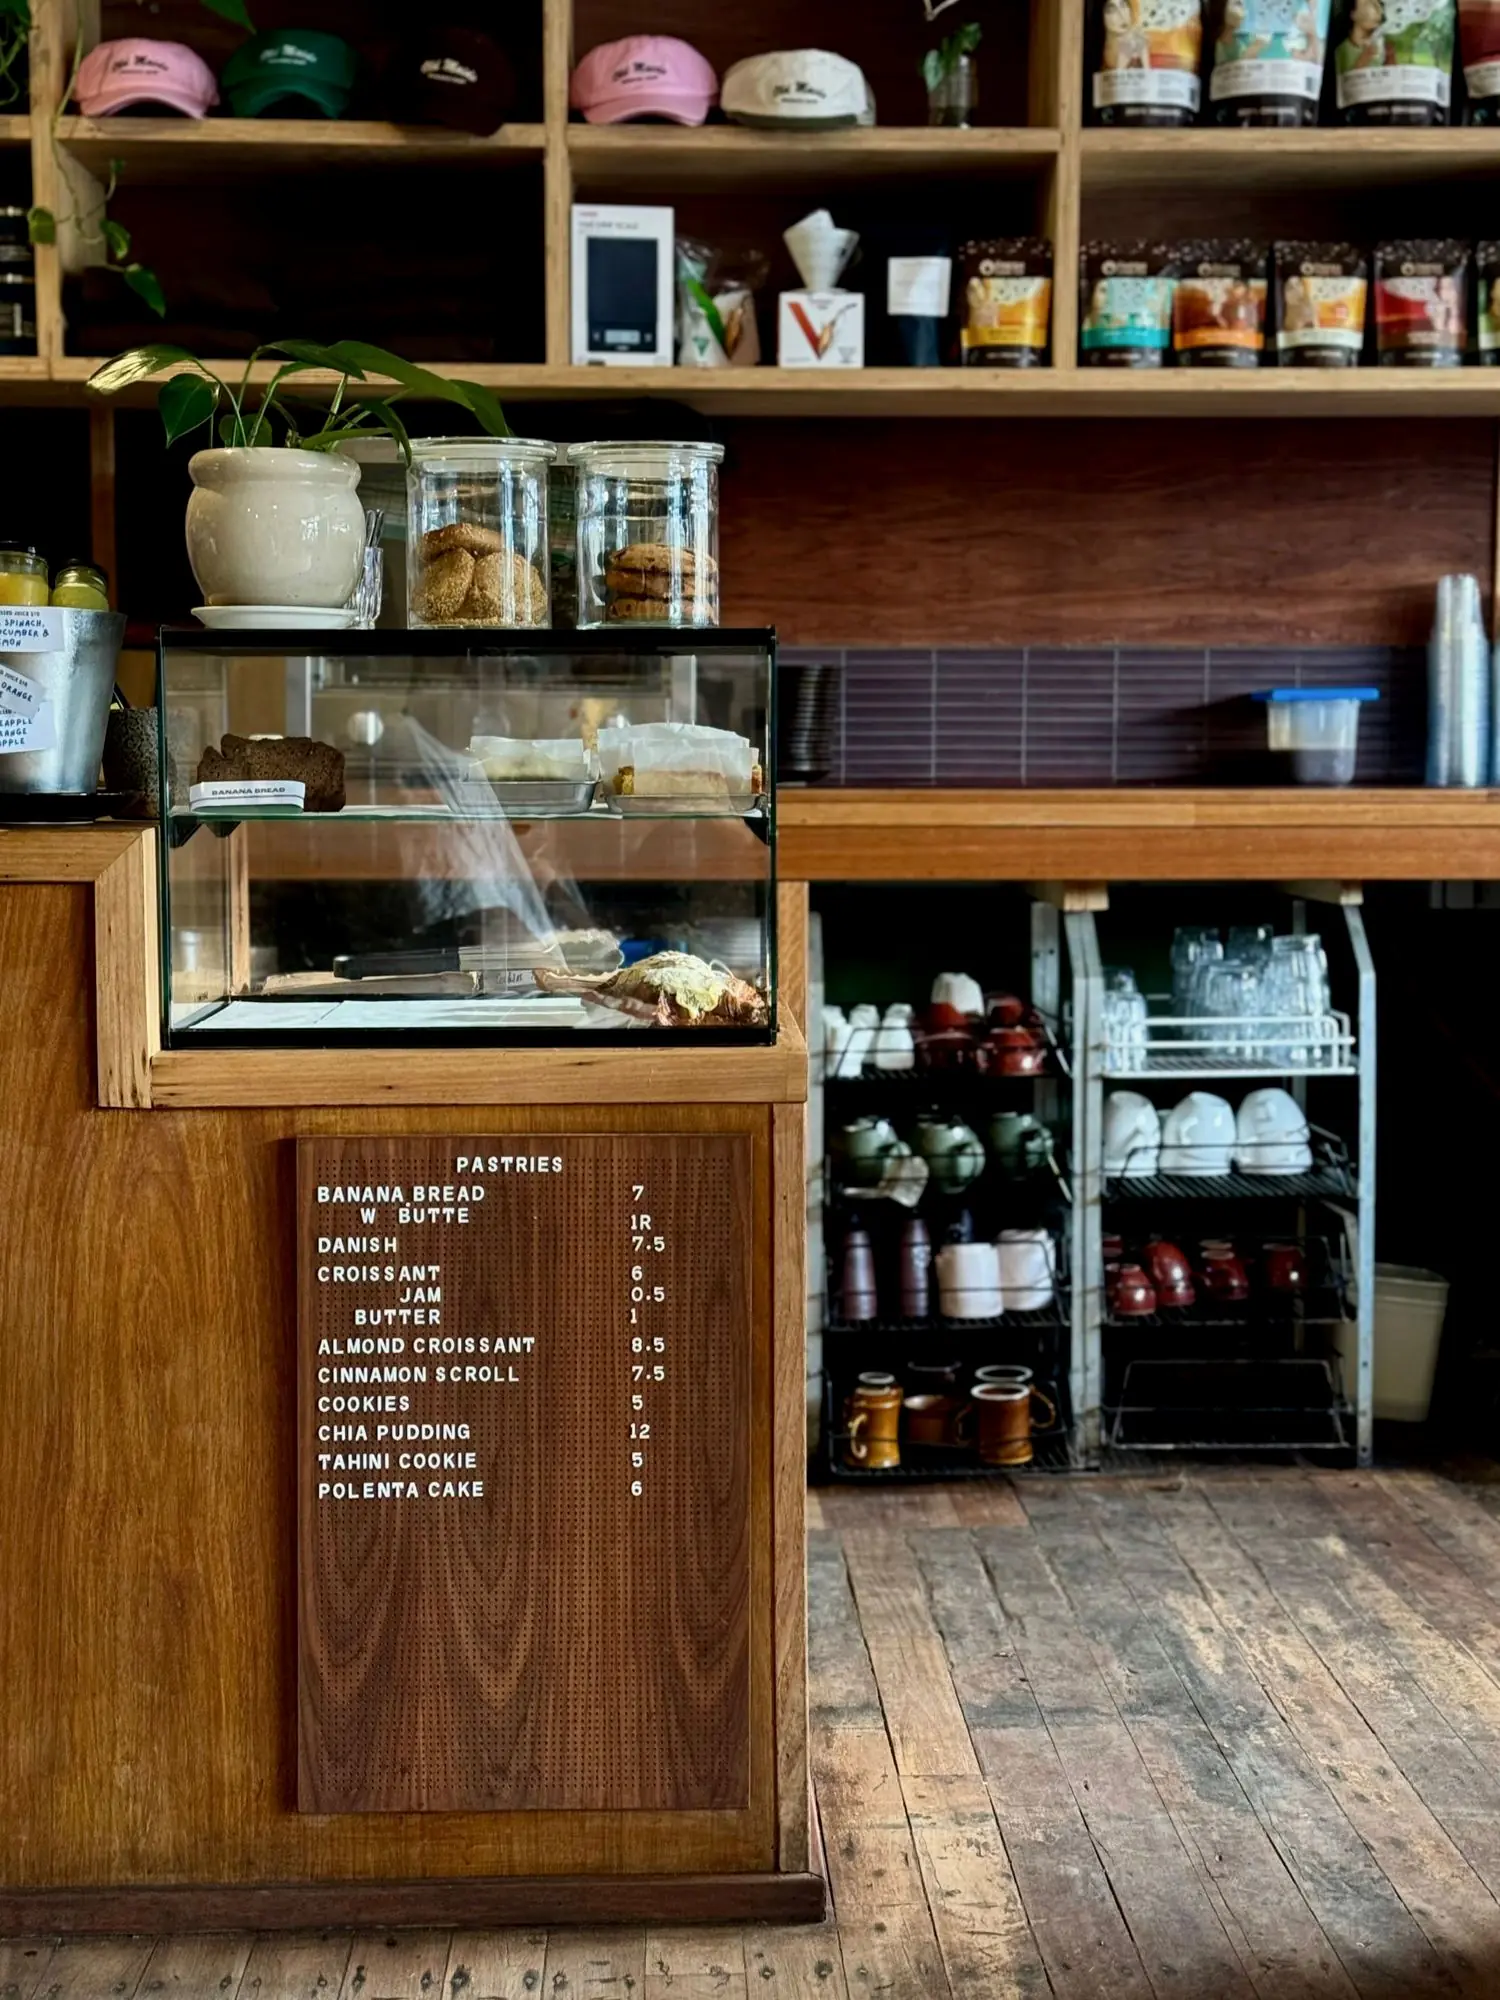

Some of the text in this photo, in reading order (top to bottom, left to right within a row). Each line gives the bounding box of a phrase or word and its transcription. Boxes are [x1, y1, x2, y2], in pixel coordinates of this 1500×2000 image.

[1, 681, 33, 702] ORANGE
[212, 786, 286, 796] BANANA BREAD
[456, 1156, 562, 1173] PASTRIES
[317, 1185, 644, 1203] BANANA BREAD 7
[360, 1207, 652, 1231] W BUTTE 1R
[318, 1235, 665, 1254] DANISH 7.5
[317, 1265, 643, 1283] CROISSANT 6
[399, 1286, 665, 1303] JAM 0.5
[355, 1308, 637, 1326] BUTTER 1
[318, 1336, 665, 1355] ALMOND CROISSANT 8.5
[318, 1365, 665, 1384] CINNAMON SCROLL 7.5
[318, 1394, 643, 1413] COOKIES 5
[318, 1422, 650, 1442] CHIA PUDDING 12
[318, 1452, 643, 1471] TAHINI COOKIE 5
[318, 1480, 643, 1500] POLENTA CAKE 6
